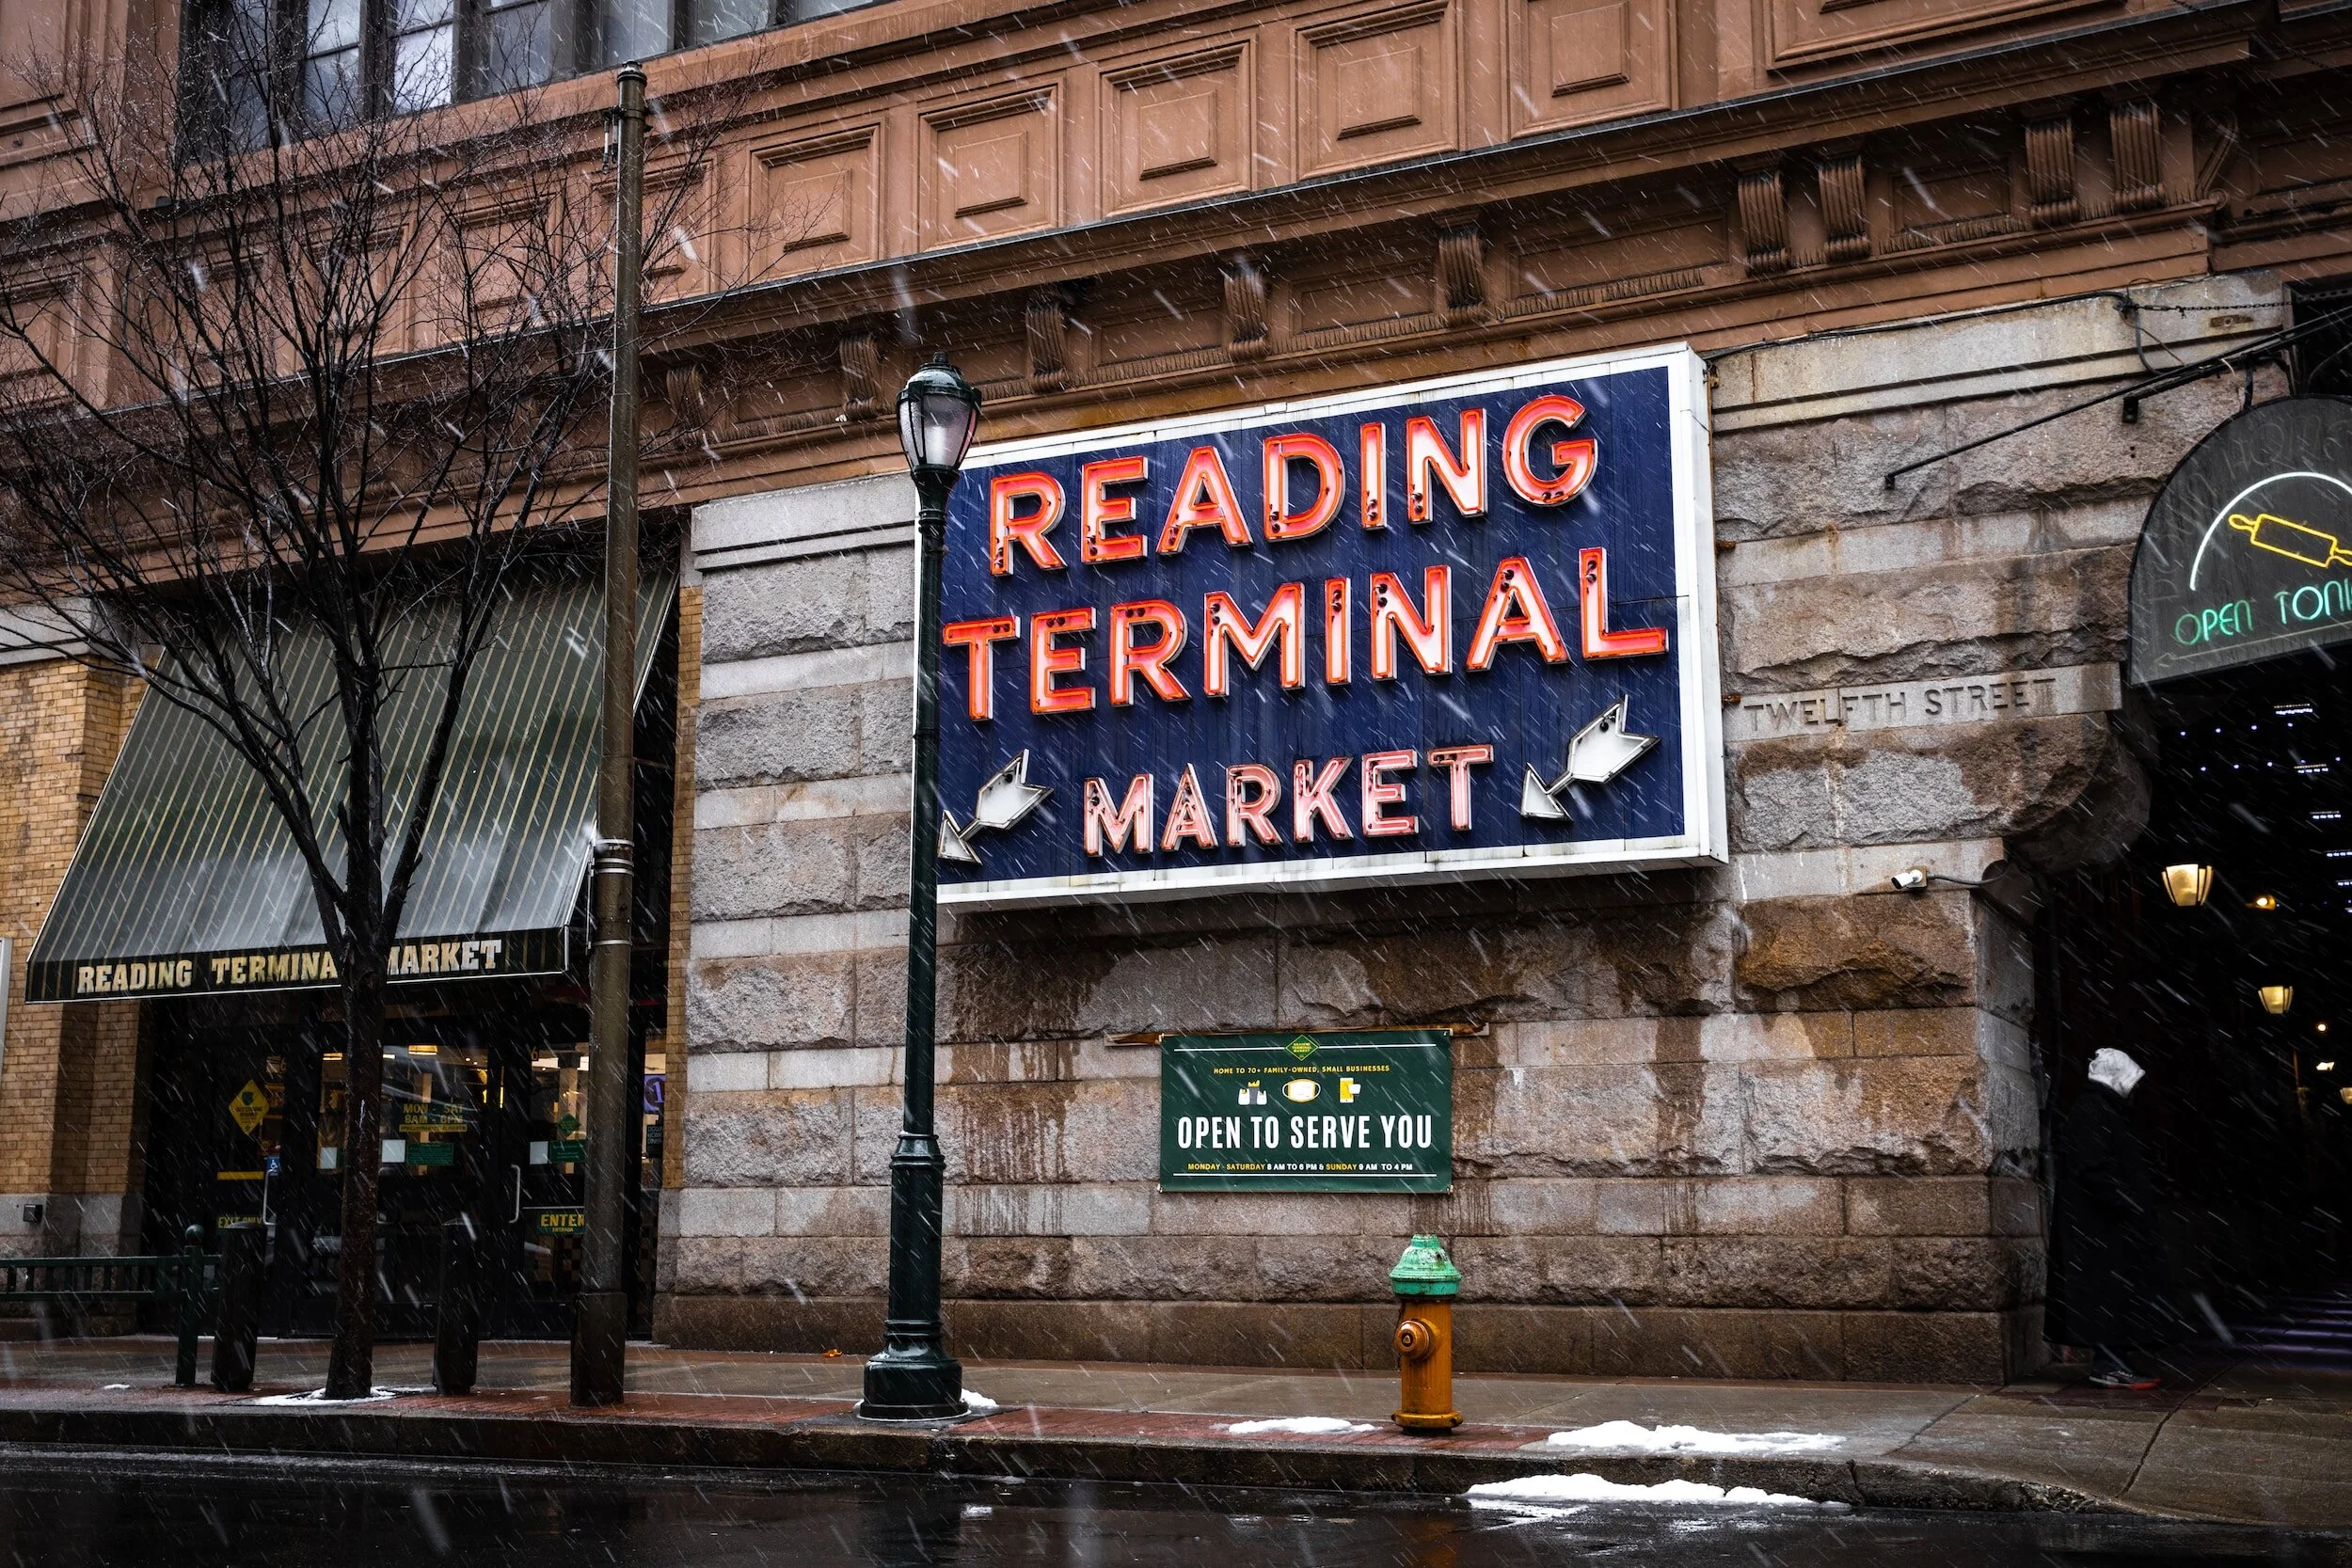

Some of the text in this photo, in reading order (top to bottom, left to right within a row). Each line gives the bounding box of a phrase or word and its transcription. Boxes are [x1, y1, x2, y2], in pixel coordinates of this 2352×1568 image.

[989, 393, 1599, 577] READING
[942, 546, 1670, 722] TERMINAL
[2174, 578, 2352, 646] OPEN TONI
[1743, 677, 2057, 733] TWELFTH STREET
[1083, 744, 1495, 858] MARKET
[76, 959, 193, 994] READING
[211, 951, 339, 985] TERMINA
[1177, 1115, 1432, 1149] OPEN TO SERVE YOU
[541, 1213, 585, 1227] ENTER
